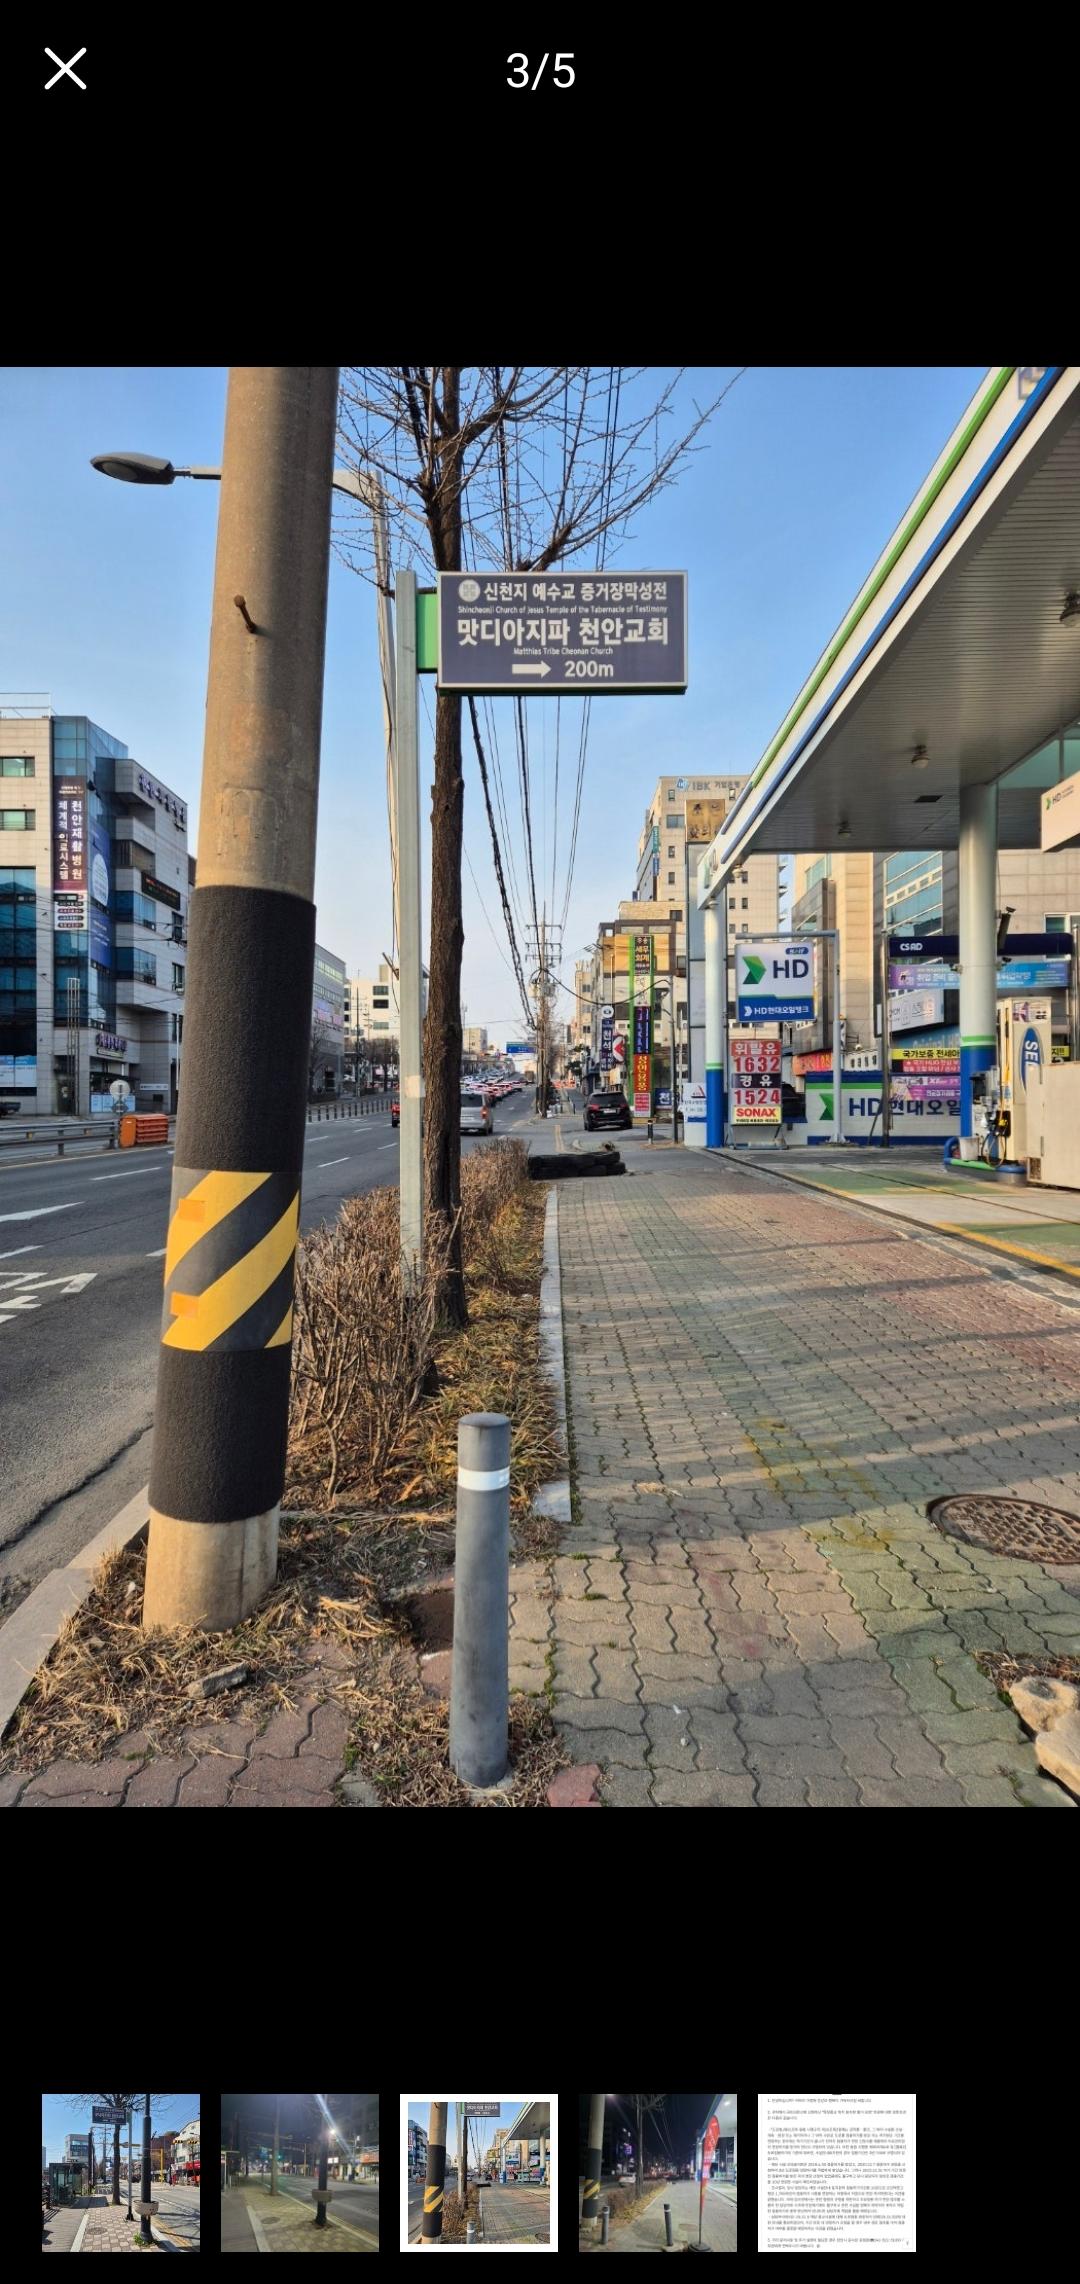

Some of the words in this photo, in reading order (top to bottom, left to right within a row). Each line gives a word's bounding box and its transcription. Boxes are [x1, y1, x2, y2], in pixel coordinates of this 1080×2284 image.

[484, 582, 528, 602] 신천지
[532, 582, 576, 602] 예수교
[580, 581, 667, 602] 증거장막성전
[496, 605, 517, 613] Church
[518, 605, 526, 613] of
[527, 606, 544, 614] Jesus
[546, 606, 569, 615] Temple
[570, 605, 577, 613] of
[578, 605, 589, 613] the
[591, 605, 625, 613] Tabernacle
[626, 605, 634, 613] of
[635, 605, 668, 615] Testimony
[457, 618, 571, 647] 맛디아지파
[578, 617, 669, 646] 천안교회
[513, 647, 542, 655] Matthias
[543, 647, 560, 655] Tribe
[561, 647, 589, 655] Cheonan
[590, 647, 614, 655] Church
[564, 660, 614, 678] 200m
[773, 959, 809, 979] HD
[734, 1057, 781, 1073] 1632
[739, 1074, 773, 1088] 경유
[734, 1089, 780, 1105] 1524
[736, 1108, 777, 1118] SONAX
